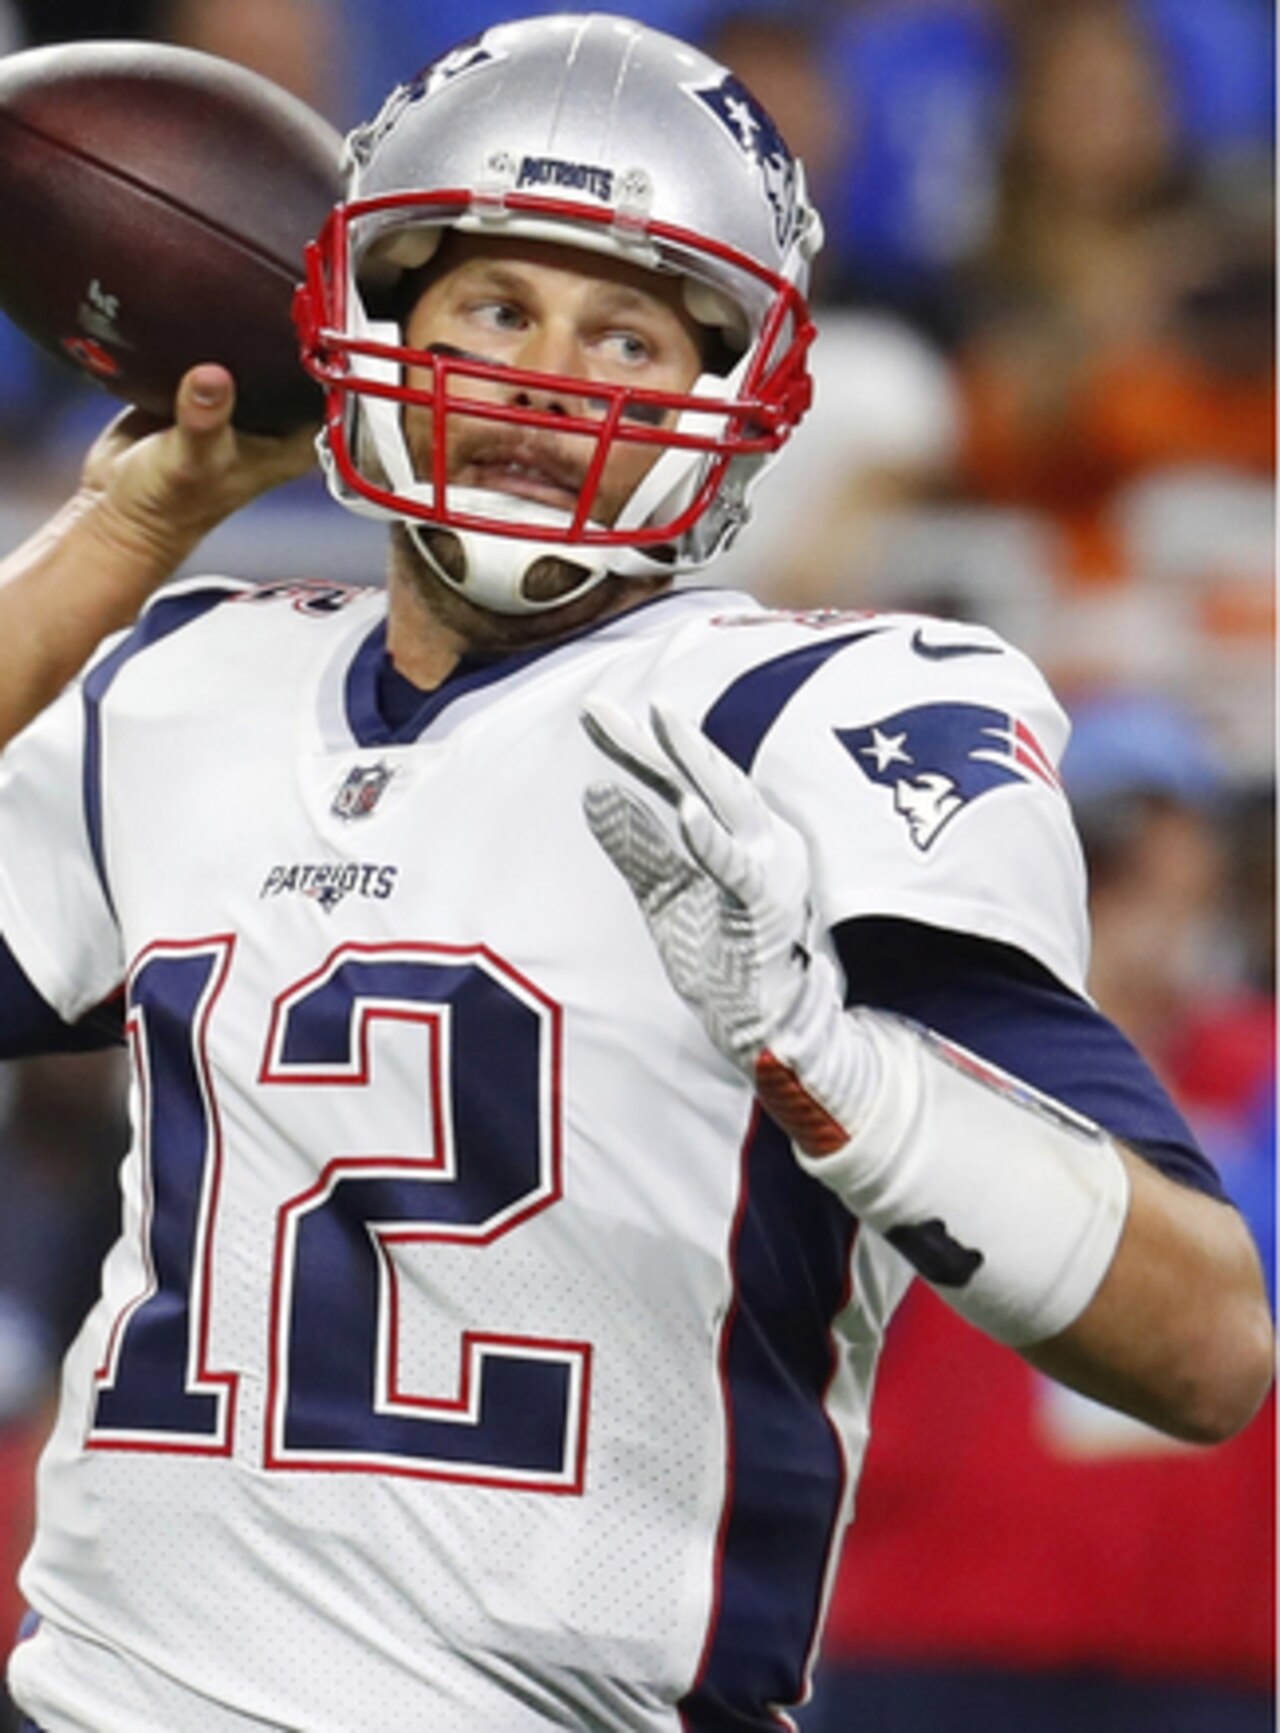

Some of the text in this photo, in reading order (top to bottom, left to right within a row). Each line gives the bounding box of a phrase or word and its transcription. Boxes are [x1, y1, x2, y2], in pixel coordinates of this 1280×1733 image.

[515, 156, 614, 202] PATRIOTS
[258, 863, 398, 899] PATRIOTS
[84, 933, 592, 1496] 12
